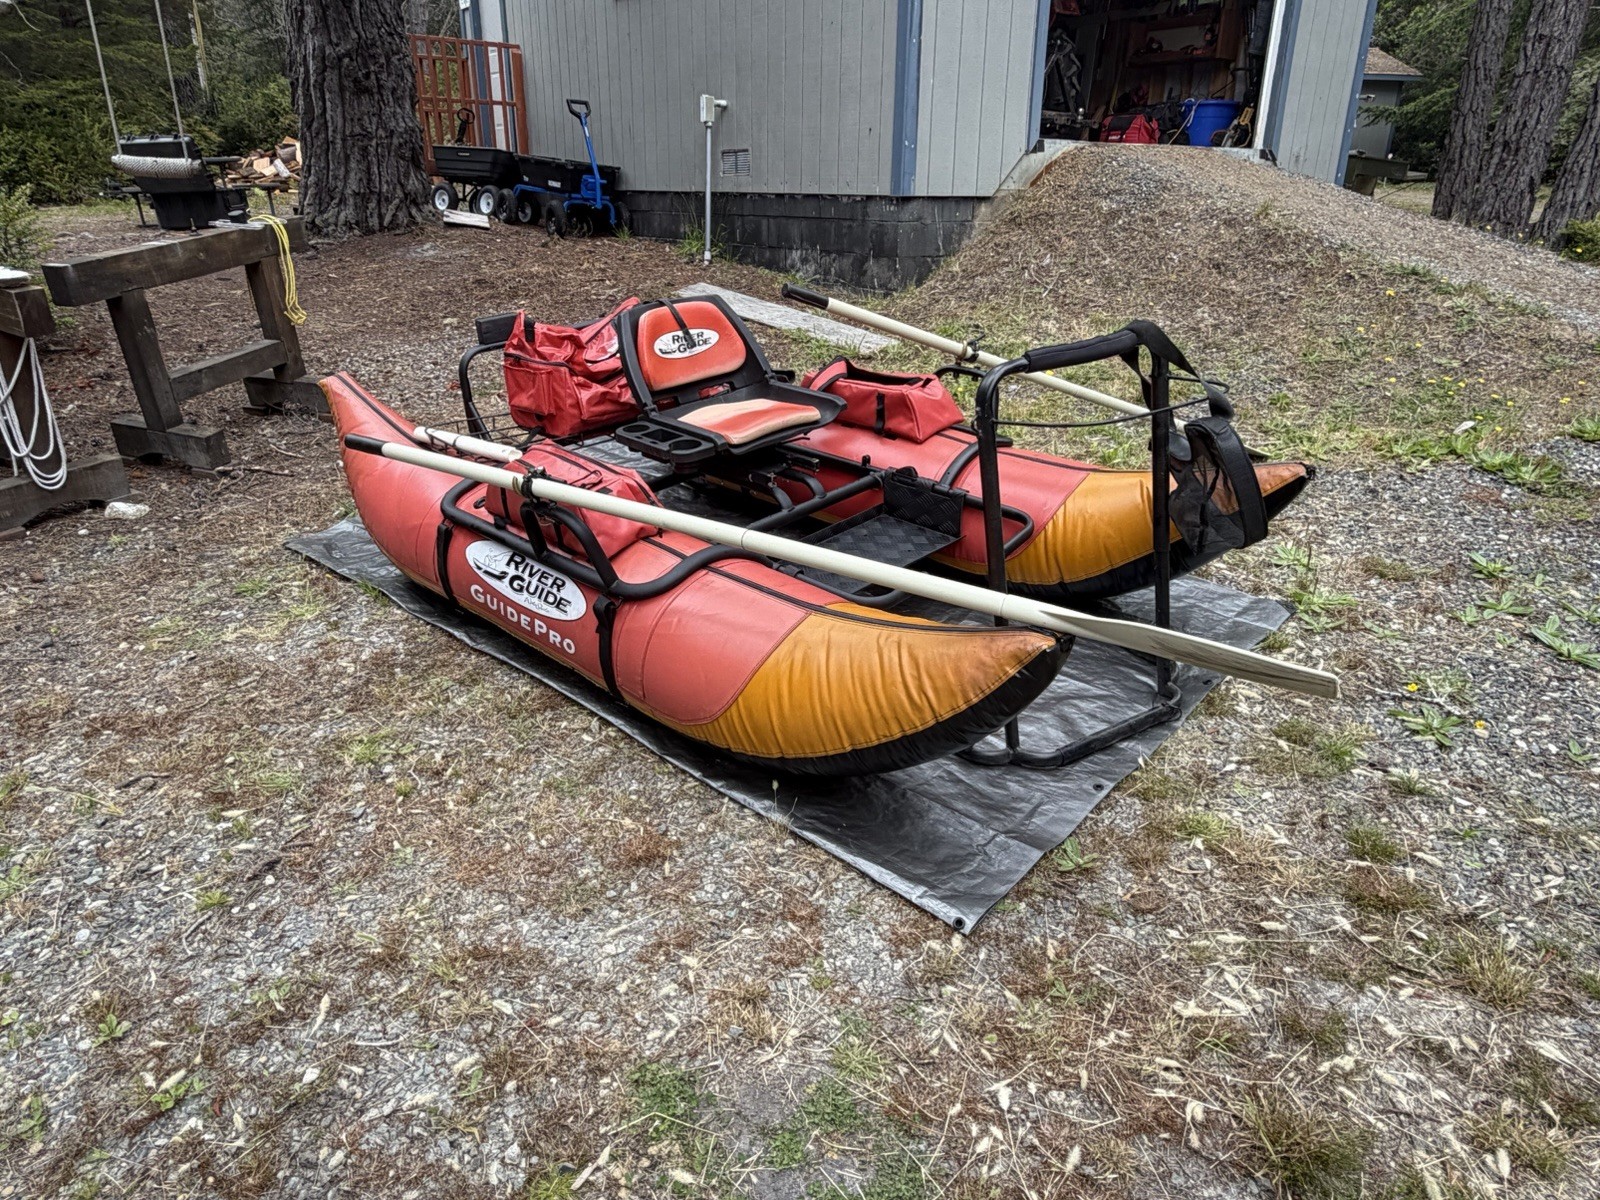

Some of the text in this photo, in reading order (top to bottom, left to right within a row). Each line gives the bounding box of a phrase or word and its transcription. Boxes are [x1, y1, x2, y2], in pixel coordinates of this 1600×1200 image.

[672, 332, 704, 344] RIER
[677, 337, 712, 353] GUDE
[506, 551, 565, 593] RIVER
[509, 574, 573, 614] GUIDE
